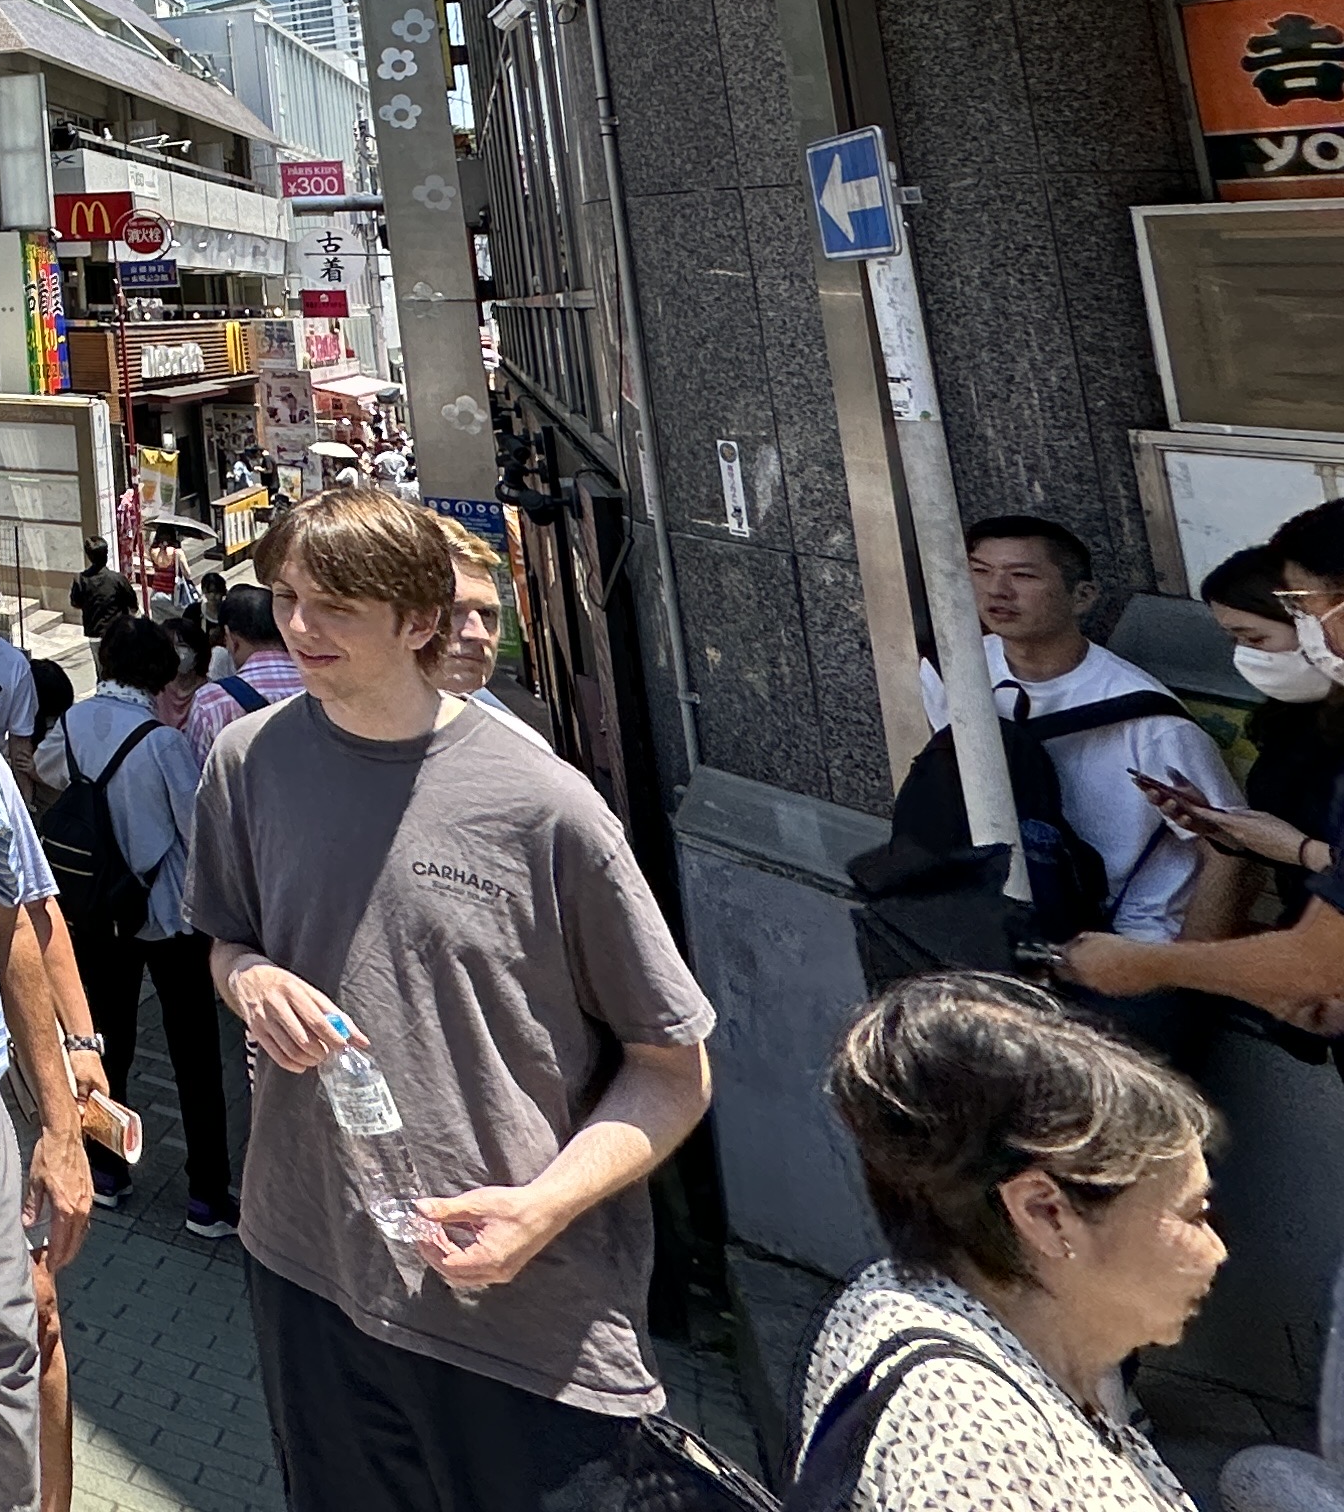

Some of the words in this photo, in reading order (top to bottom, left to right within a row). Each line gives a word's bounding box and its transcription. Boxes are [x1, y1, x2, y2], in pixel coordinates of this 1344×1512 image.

[287, 166, 313, 176] PARIS
[287, 176, 339, 195] ¥300
[127, 228, 161, 243] 消火栓
[316, 231, 345, 283] 古着
[412, 860, 518, 903] CARHARTT
